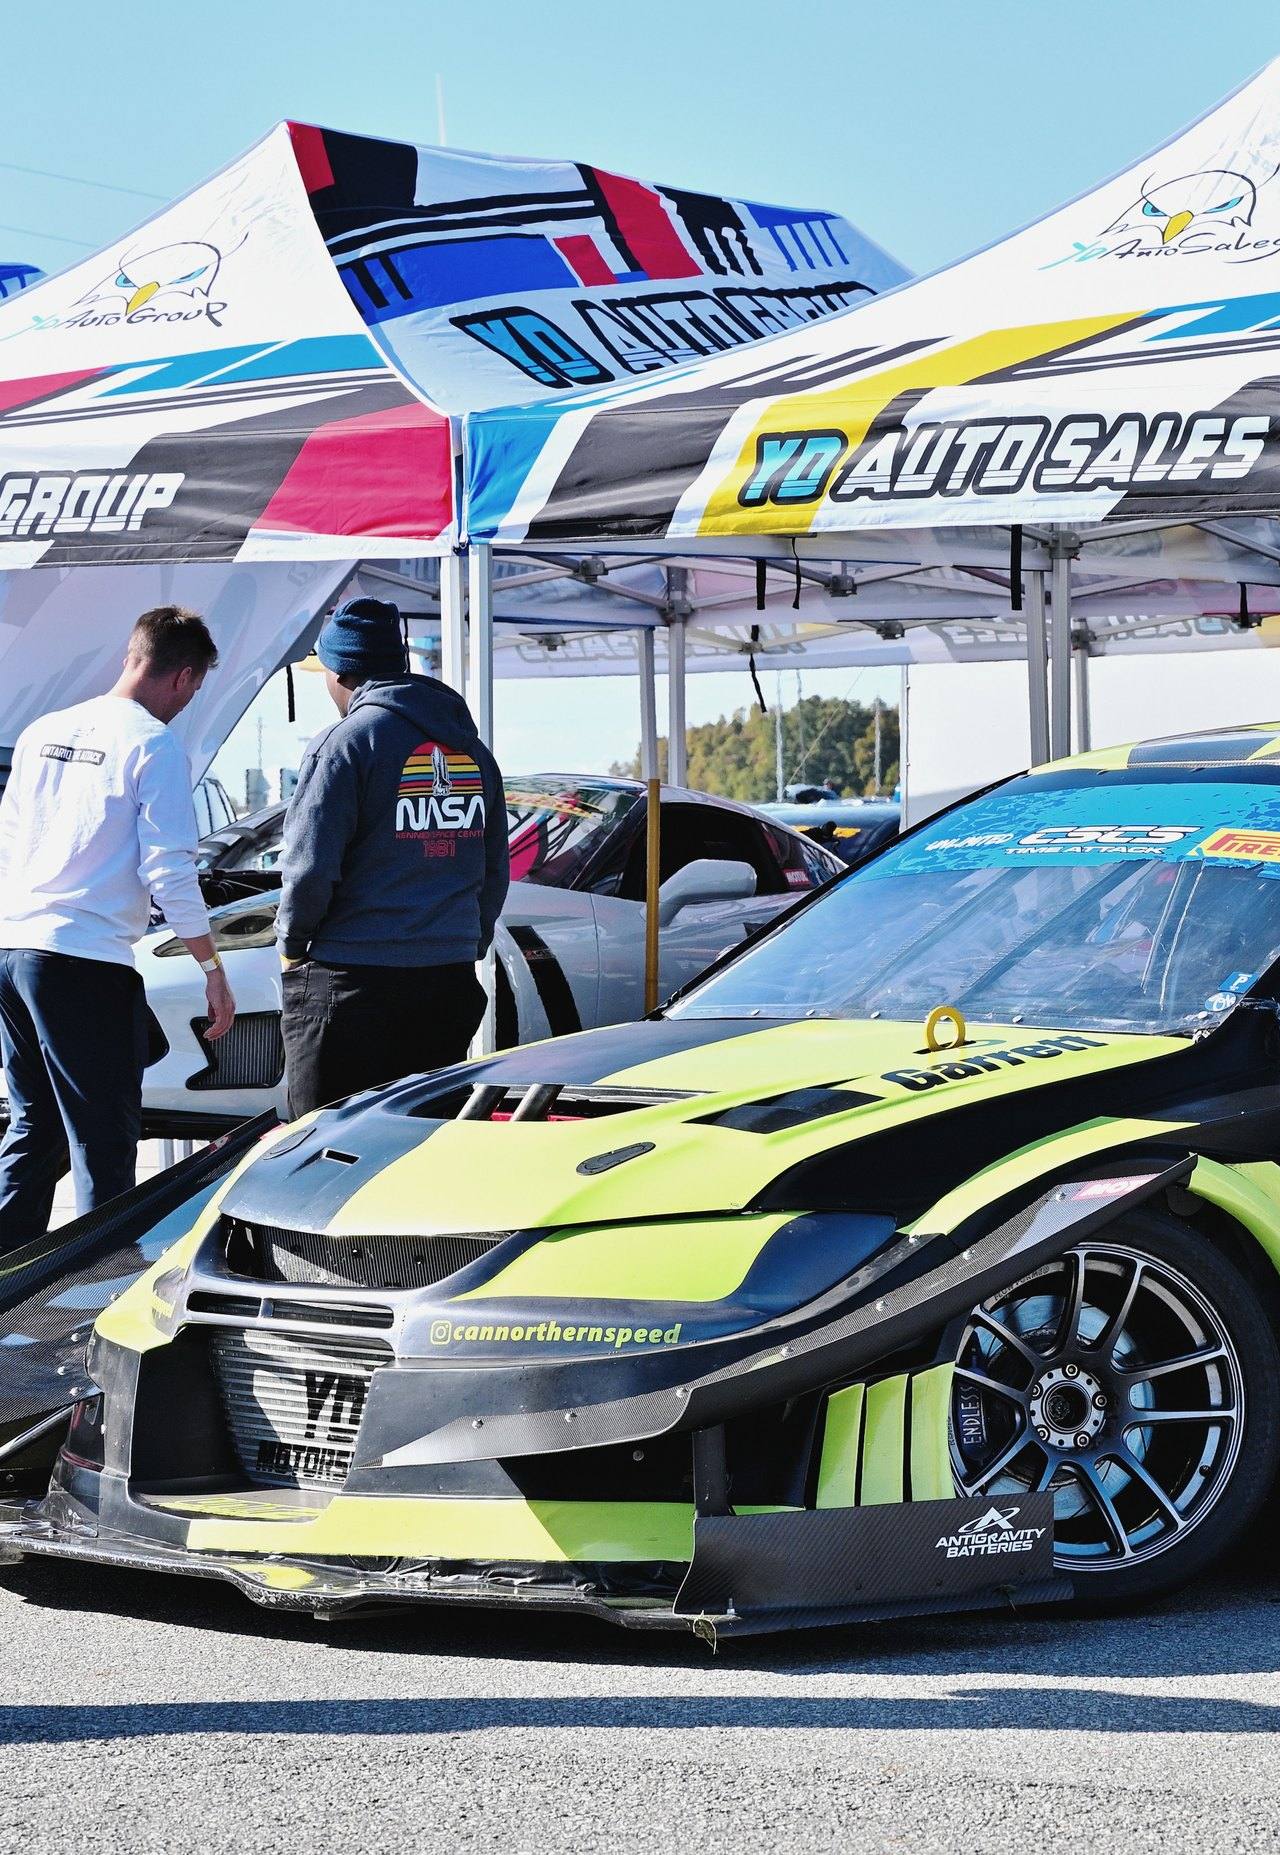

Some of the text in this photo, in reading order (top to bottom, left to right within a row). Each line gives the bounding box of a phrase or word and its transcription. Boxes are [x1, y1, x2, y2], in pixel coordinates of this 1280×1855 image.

[840, 423, 1042, 494] AUTO
[1041, 415, 1270, 487] SALES
[0, 472, 186, 535] GROUP
[395, 794, 486, 832] NASA
[1005, 845, 1169, 856] TIME ATTACK
[1017, 825, 1203, 846] CSCS
[880, 1035, 1110, 1091] Garrett
[453, 1321, 682, 1349] cannorthernspeed
[960, 1385, 982, 1446] ENDLESS
[256, 1440, 355, 1482] MOTORS
[934, 1527, 1047, 1549] ANTIGRAVITY
[946, 1539, 1034, 1559] BATTERIES
